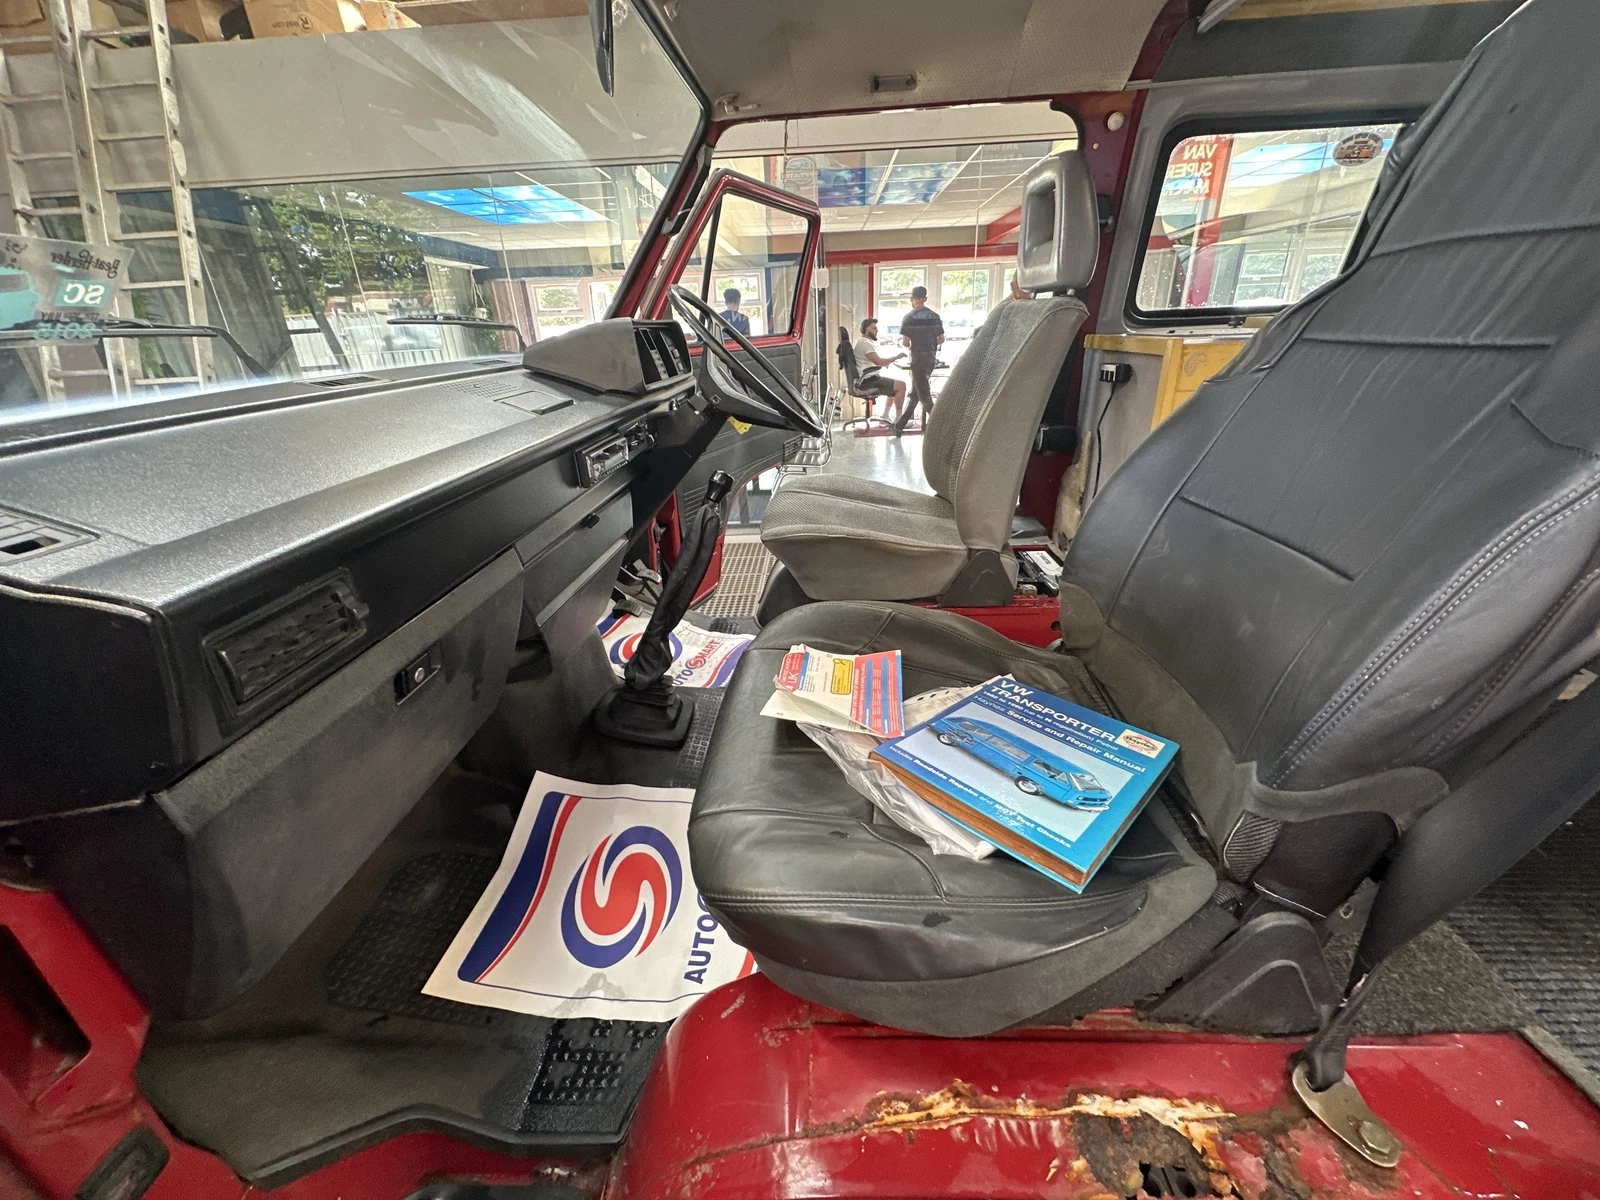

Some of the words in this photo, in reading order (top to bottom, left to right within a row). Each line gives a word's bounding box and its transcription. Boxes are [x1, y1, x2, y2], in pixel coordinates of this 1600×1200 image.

[991, 685, 1117, 742] TRANSPORTER
[1000, 680, 1034, 696] VW
[973, 695, 1007, 712] Haynes
[1006, 710, 1043, 728] Service
[1044, 726, 1065, 738] and
[1065, 735, 1102, 754] Repair
[1103, 752, 1146, 773] Manual
[888, 746, 913, 761] Includes
[913, 759, 948, 780] Roadside
[949, 778, 979, 797] Repairs
[978, 795, 994, 805] and
[1036, 826, 1072, 849] Checks
[683, 891, 718, 985] AUTO
